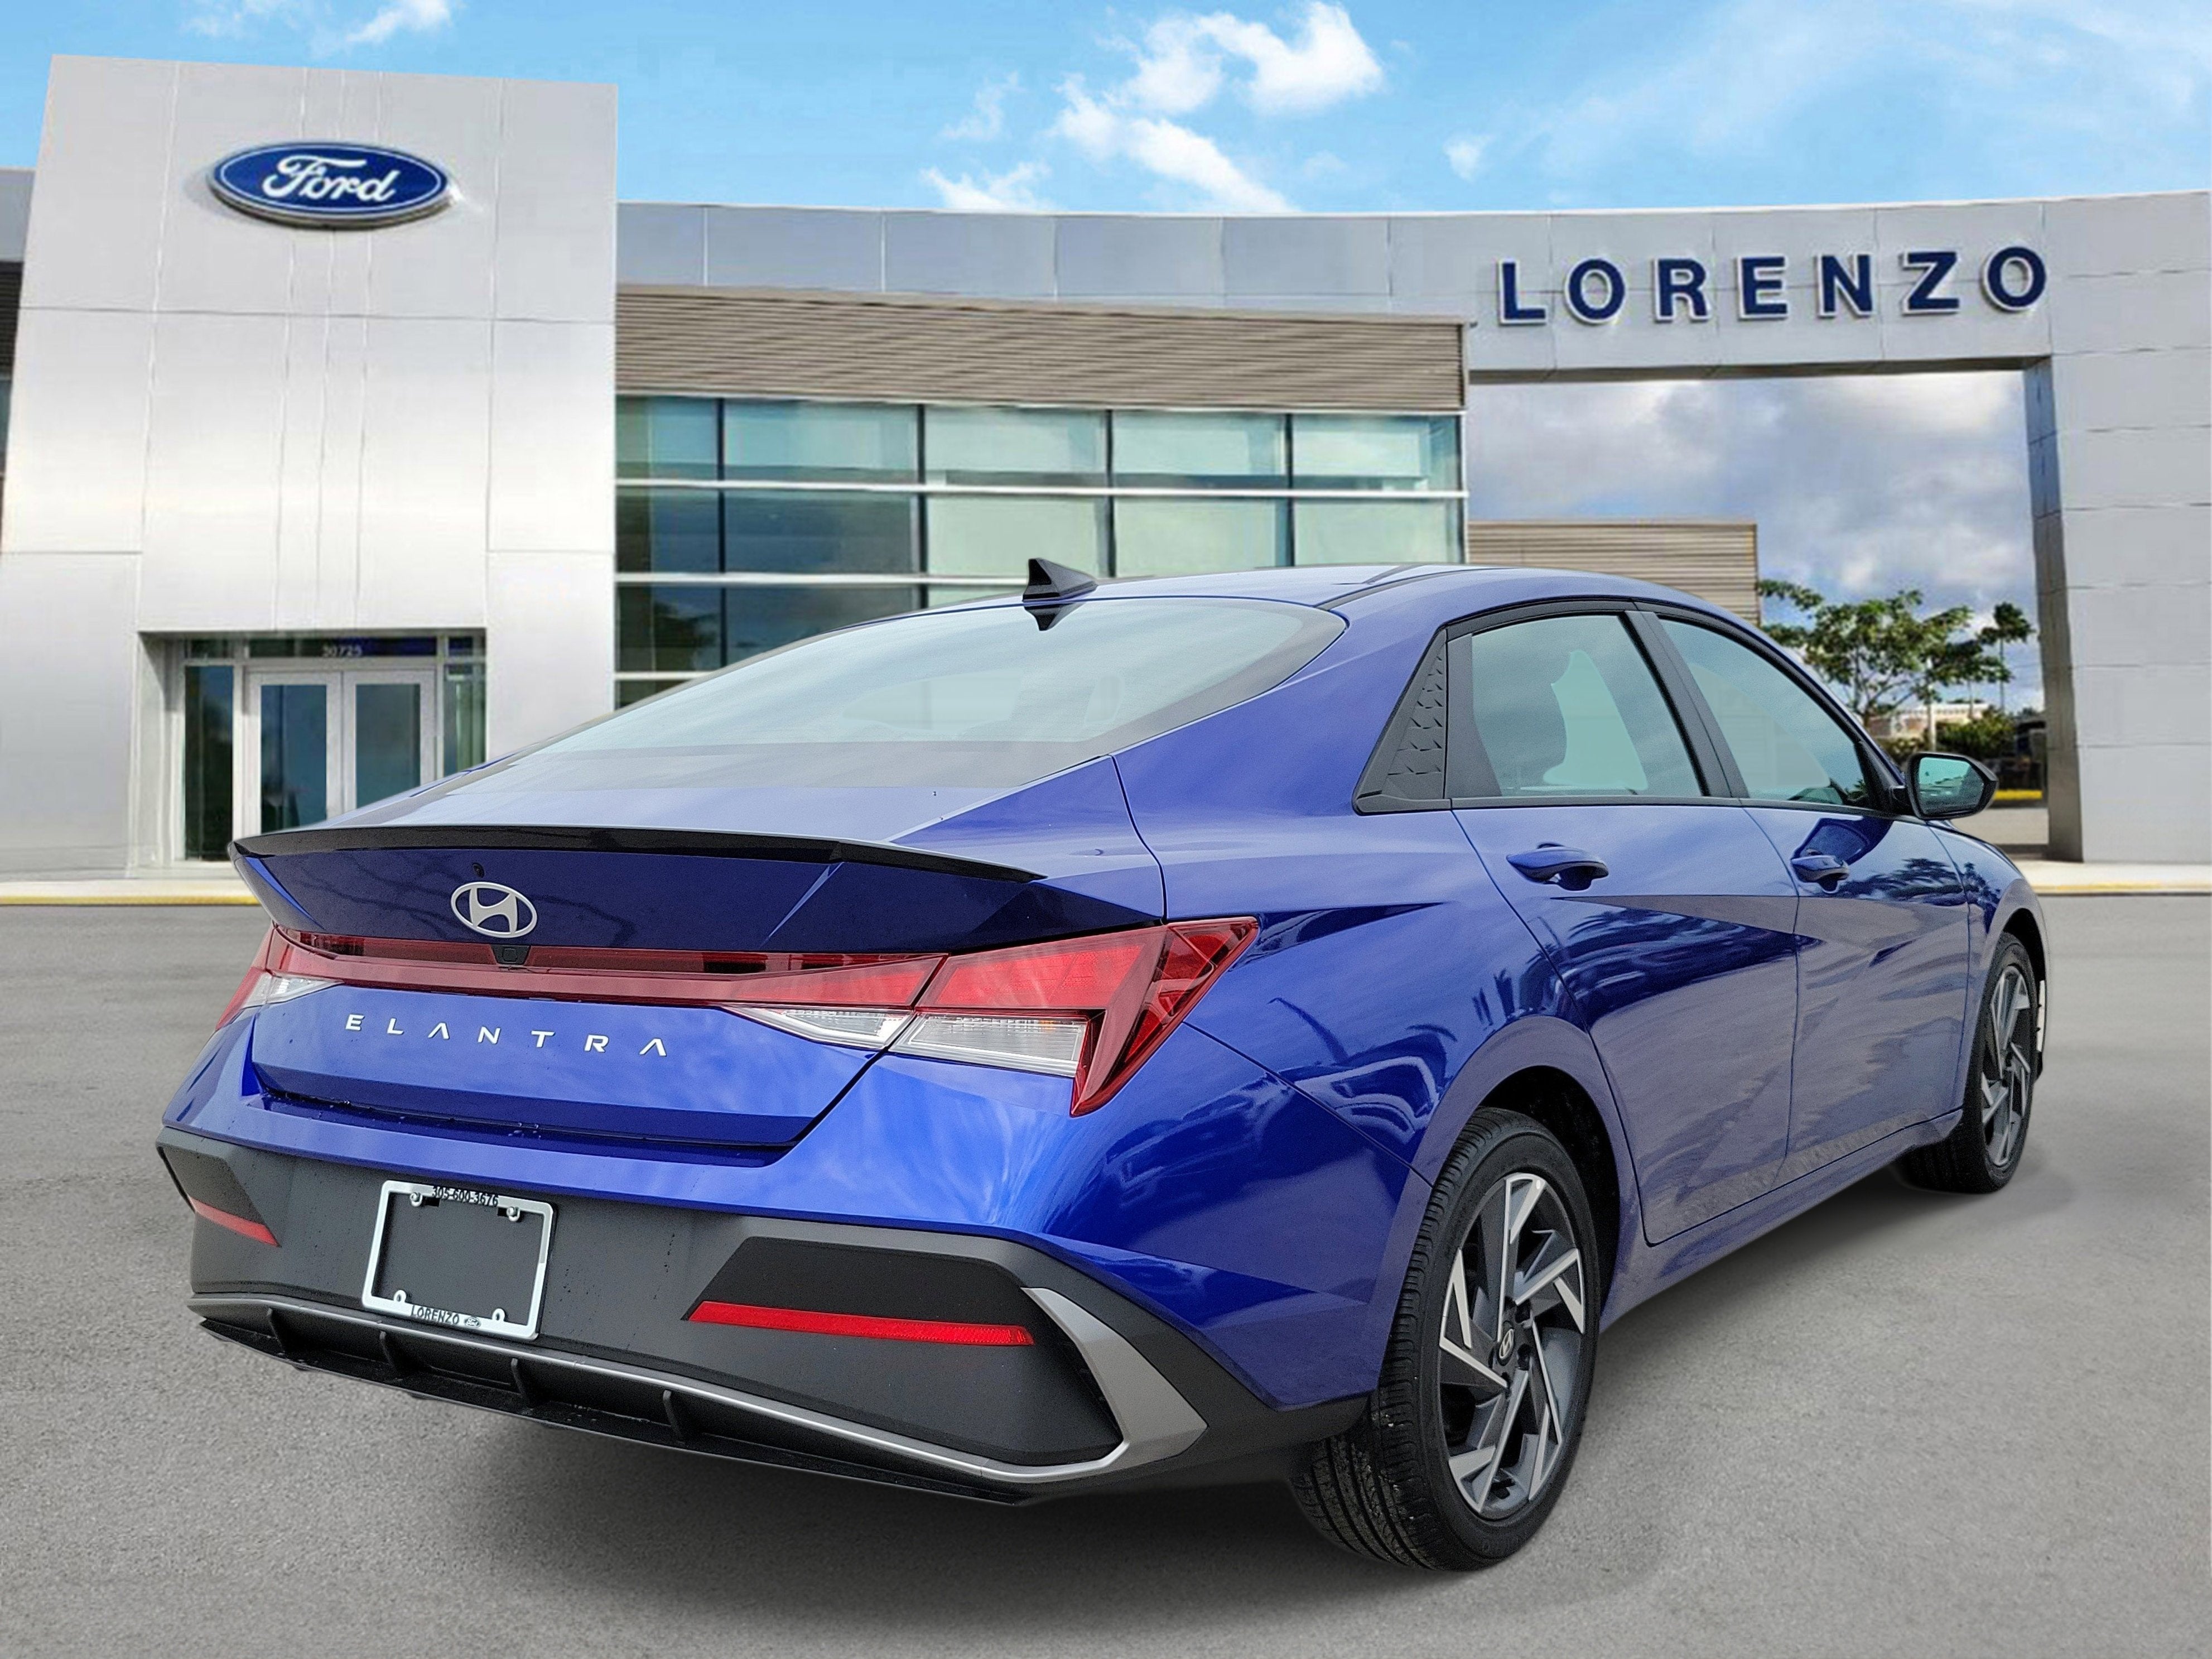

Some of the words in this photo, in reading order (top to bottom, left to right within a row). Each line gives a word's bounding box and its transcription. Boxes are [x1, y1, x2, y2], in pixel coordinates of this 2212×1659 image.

[262, 155, 401, 201] Ford
[1498, 246, 2047, 325] LORENZO
[345, 1014, 667, 1056] ELANTRA
[432, 1185, 499, 1208] 305-600-3676
[411, 1304, 460, 1325] LORENZO
